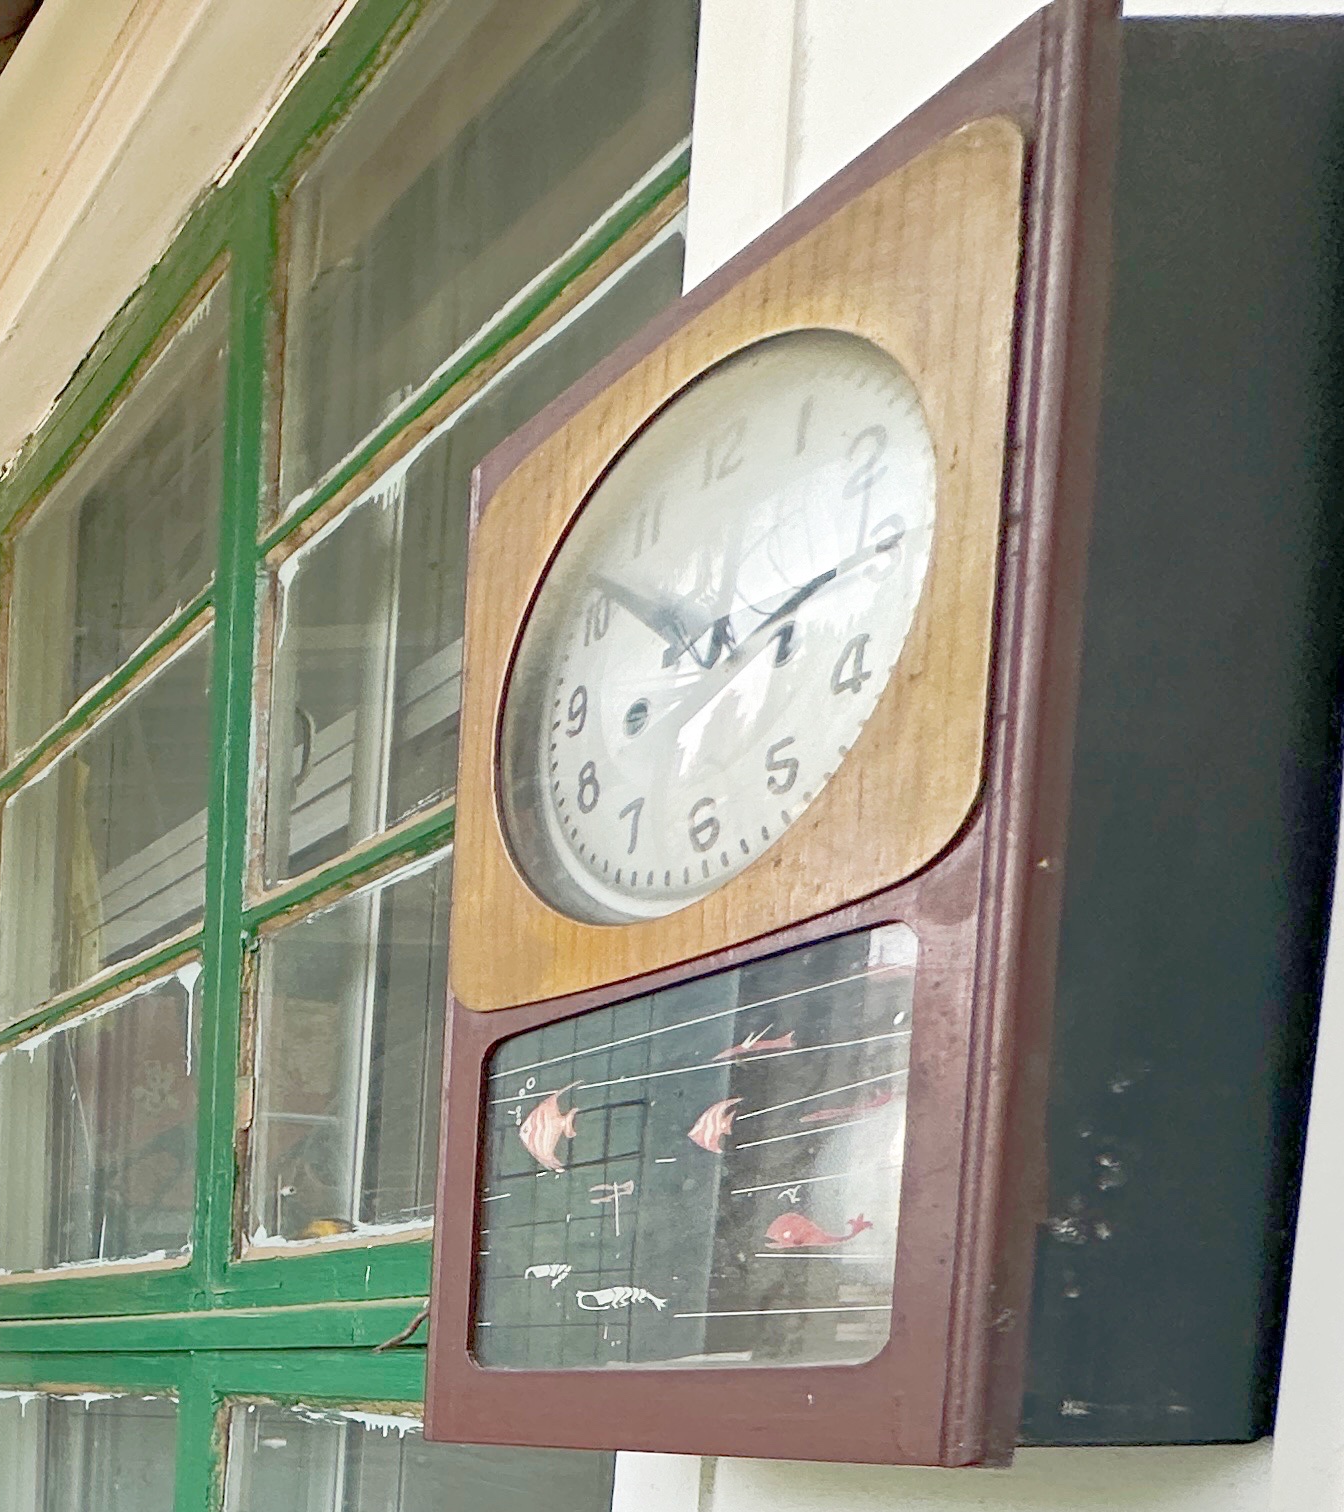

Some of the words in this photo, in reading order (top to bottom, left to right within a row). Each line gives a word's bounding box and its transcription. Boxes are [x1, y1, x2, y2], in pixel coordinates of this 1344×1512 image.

[703, 417, 750, 488] 12
[841, 424, 890, 499] 2
[830, 633, 872, 696] 4
[565, 685, 588, 739] 9
[576, 760, 600, 814] 8
[765, 736, 800, 796] 5
[618, 797, 646, 855] 7
[688, 797, 721, 854] 6
